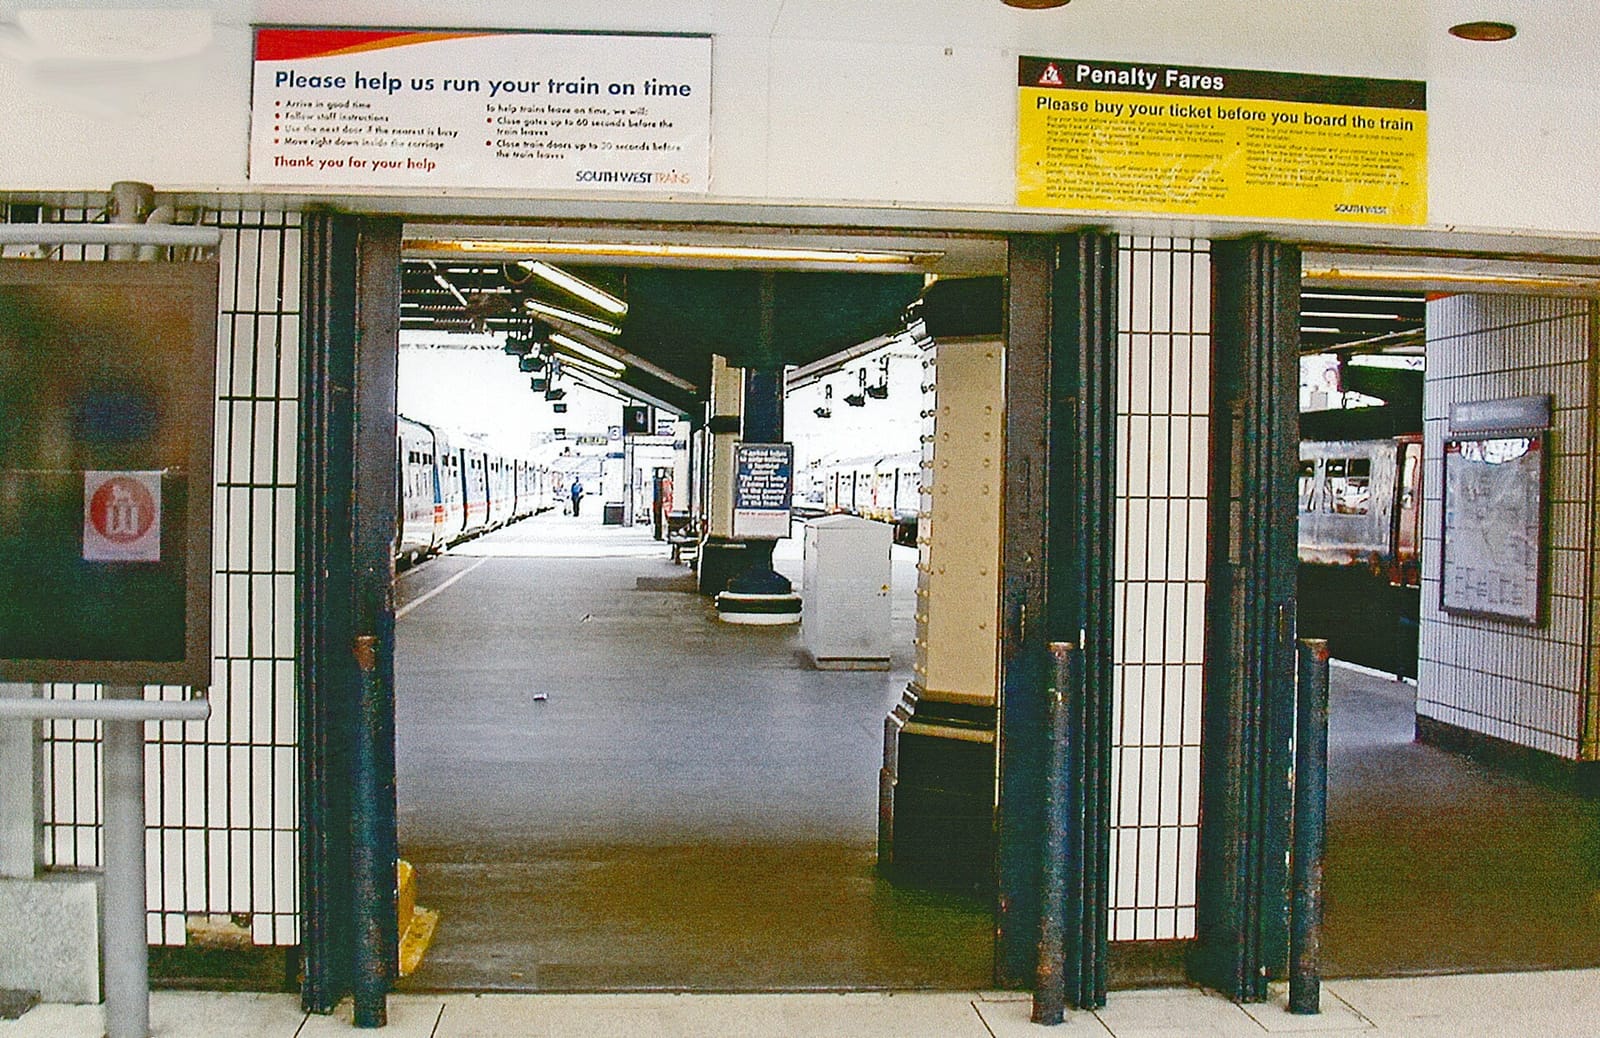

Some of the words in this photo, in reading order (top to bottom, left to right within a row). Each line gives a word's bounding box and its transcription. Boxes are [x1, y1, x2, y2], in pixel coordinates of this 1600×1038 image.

[1076, 64, 1157, 90] Penalty
[1166, 70, 1224, 90] Fares
[276, 70, 346, 88] Please
[355, 71, 402, 95] help
[410, 78, 434, 91] us
[443, 79, 480, 92] run
[488, 80, 540, 97] your
[548, 76, 599, 94] train
[608, 82, 635, 95] on
[644, 78, 692, 96] time
[326, 100, 349, 110] good
[352, 101, 371, 109] time
[498, 104, 516, 114] help
[520, 105, 545, 113] trains
[548, 105, 571, 114] leave
[588, 106, 610, 116] time,
[285, 112, 314, 120] Follow
[317, 112, 337, 120] staff
[339, 112, 389, 122] instructions
[1036, 96, 1088, 112] Please
[1094, 100, 1124, 117] buy
[1129, 104, 1165, 118] your
[1170, 104, 1212, 118] ticket
[1218, 106, 1266, 121] before
[1272, 112, 1298, 125] you
[1304, 112, 1347, 127] board
[1352, 115, 1375, 128] the
[1380, 118, 1413, 131] train
[496, 117, 521, 125] Close
[524, 118, 548, 127] gates
[550, 120, 562, 128] up
[591, 119, 626, 128] seconds
[628, 119, 656, 128] before
[659, 120, 673, 128] the
[375, 126, 389, 134] the
[392, 127, 425, 136] nearest
[427, 127, 435, 136] is
[437, 127, 458, 138] busy
[521, 128, 548, 136] leaves
[310, 138, 332, 148] right
[334, 138, 359, 146] down
[390, 139, 404, 147] the
[407, 141, 444, 150] carriage
[496, 140, 520, 148] Close
[523, 140, 544, 148] train
[547, 140, 571, 149] doors
[575, 143, 586, 151] up
[616, 143, 649, 151] seconds
[652, 143, 681, 151] before
[496, 150, 509, 158] the
[537, 151, 564, 159] leaves
[274, 156, 314, 167] Thank
[319, 159, 344, 170] you
[348, 156, 366, 168] for
[372, 160, 402, 171] your
[407, 158, 436, 172] help
